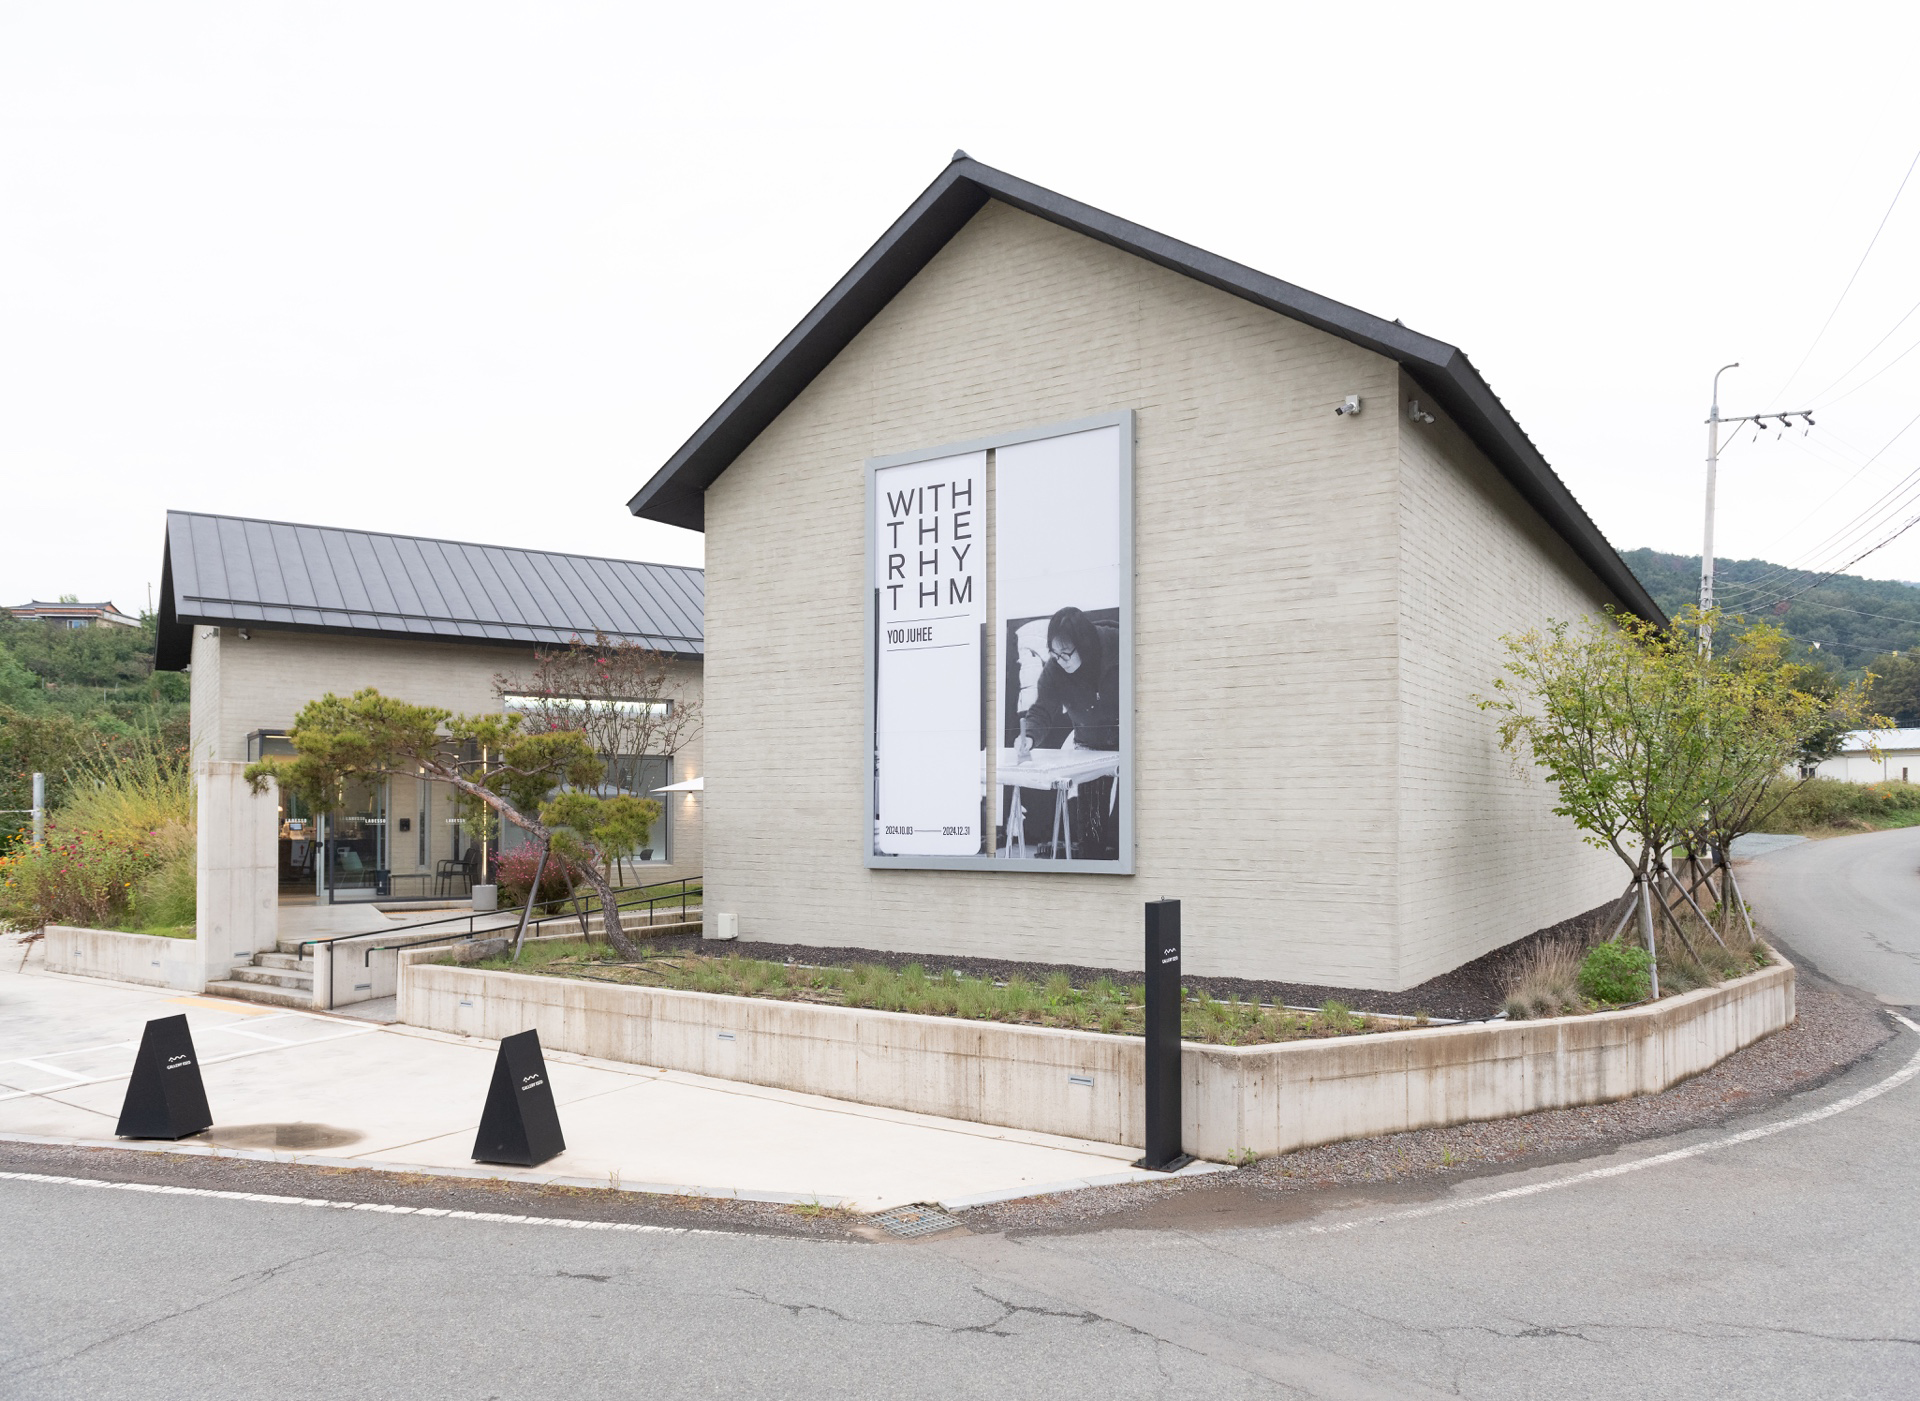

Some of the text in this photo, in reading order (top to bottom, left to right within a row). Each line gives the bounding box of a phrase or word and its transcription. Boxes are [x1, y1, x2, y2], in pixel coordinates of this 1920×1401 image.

[886, 478, 972, 518] WITH
[886, 510, 972, 549] THE
[887, 544, 972, 580] RHY
[886, 576, 972, 610] THM
[887, 626, 933, 644] YOO JUHEE
[885, 825, 971, 836] 2024.10.03 2024.12.31
